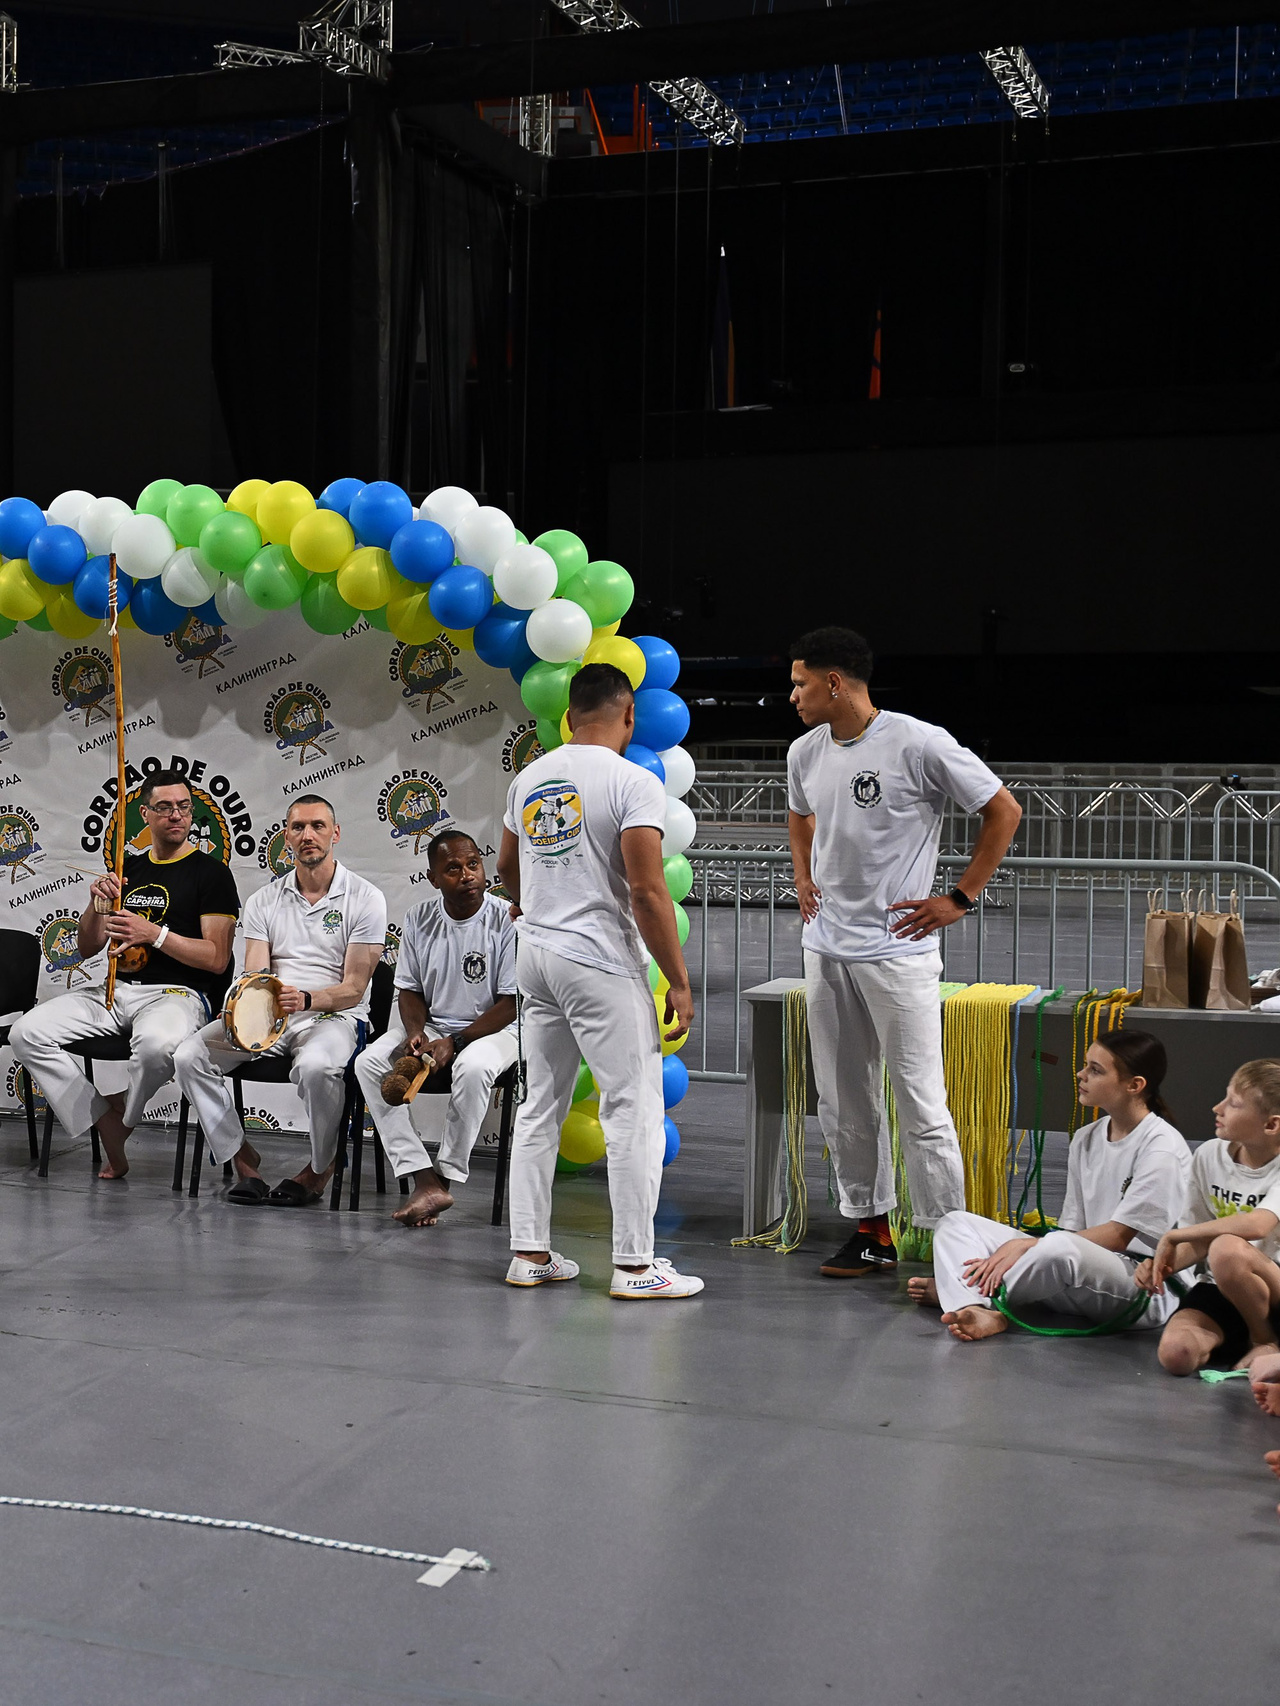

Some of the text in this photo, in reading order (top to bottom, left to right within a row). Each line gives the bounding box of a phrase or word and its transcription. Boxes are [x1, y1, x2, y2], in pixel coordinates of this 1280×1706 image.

[51, 646, 114, 696] CORDÃO DE OURO
[215, 652, 297, 694] КАЛИНИНГРАД
[389, 632, 460, 681] CORDÃ URO
[263, 681, 331, 733] CORDÃO DE OURO
[411, 700, 498, 743] КАЛИНИНГРАД
[501, 724, 527, 773] CORDÃO
[282, 754, 365, 795] КАЛИНИНГРАД
[377, 769, 448, 822] CORDÃO DE OURO
[0, 804, 13, 814] DE
[16, 806, 40, 832] OURO
[81, 755, 256, 857] CORDÃO DE OURO
[258, 822, 281, 869] CORDÃO
[9, 872, 84, 909] КАЛИНИНГРАД
[126, 897, 166, 905] CAPOEIRA
[55, 908, 69, 918] DE
[6, 1059, 22, 1097] CORDÃ
[243, 1107, 282, 1130] DE OUR
[1211, 1184, 1242, 1206] THE
